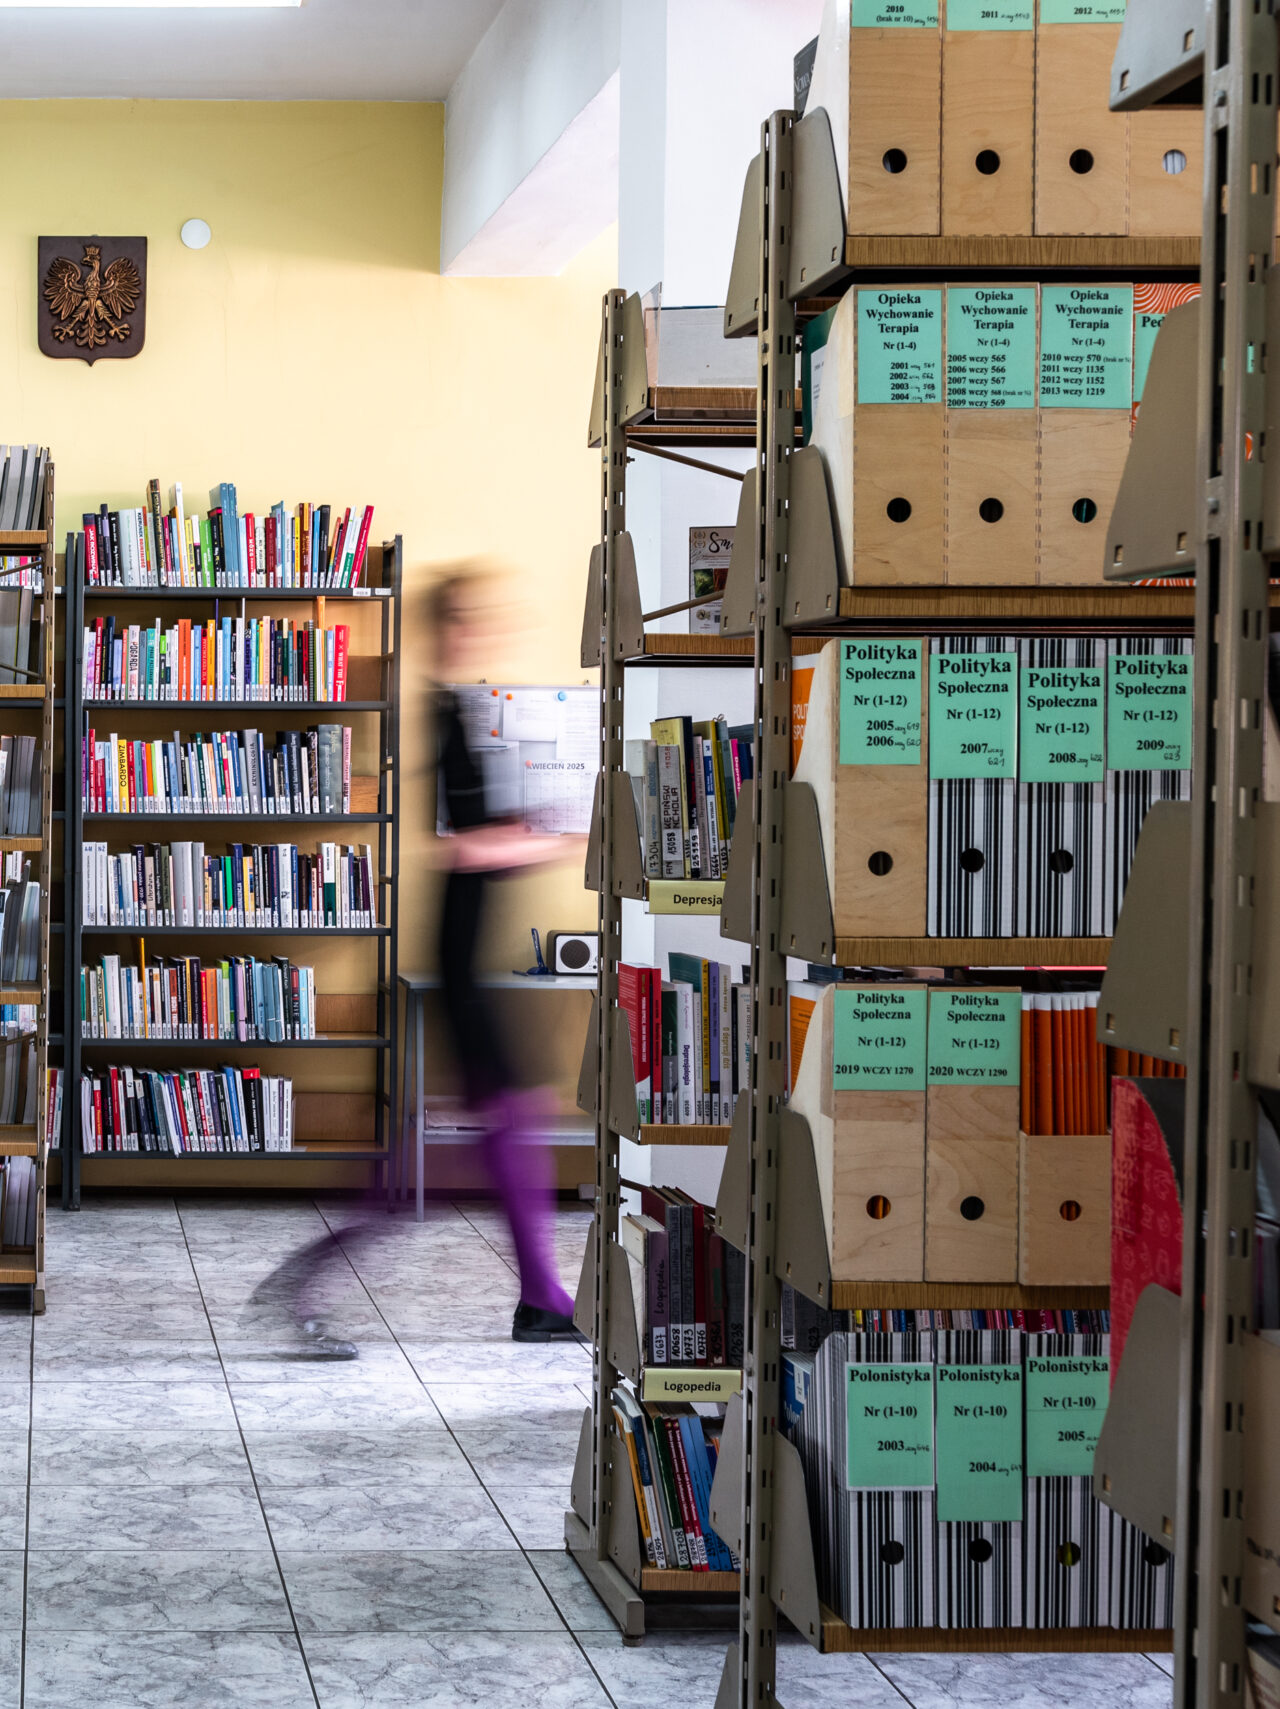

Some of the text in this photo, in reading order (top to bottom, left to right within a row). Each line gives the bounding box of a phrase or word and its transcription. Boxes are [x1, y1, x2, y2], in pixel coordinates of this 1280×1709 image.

[878, 294, 921, 306] Opieka
[975, 291, 1013, 302] Opieka
[1070, 290, 1109, 302] Opieka
[866, 309, 933, 321] Wychowanie
[961, 305, 1028, 317] Wychowanie
[1056, 304, 1123, 316] Wychowanie
[878, 323, 919, 335] Terapia
[974, 320, 1014, 331] Terapia
[1069, 319, 1109, 331] Terapia
[897, 342, 916, 351] (1-4)
[991, 338, 1010, 347] (1-4)
[1085, 338, 1105, 347] (1-4)
[845, 645, 917, 663] Polityka
[939, 659, 1011, 677] Polityka
[1115, 660, 1188, 679] Polityka
[846, 668, 915, 682] Społeczna
[1028, 673, 1100, 691] Polityka
[938, 682, 1008, 697] Społeczna
[1115, 683, 1186, 698] Społeczna
[854, 695, 907, 707] Nr (1-12)
[1027, 696, 1097, 711] Społeczna
[947, 709, 1001, 720] Nr (1-12)
[1123, 711, 1178, 723] Nr (1-12)
[867, 721, 894, 730] 2005
[1036, 723, 1089, 735] Nr (1-12)
[867, 736, 894, 746] 2006
[1137, 740, 1164, 750] 2009
[961, 744, 988, 753] 2007
[1049, 753, 1076, 763] 2008
[673, 894, 722, 906] Depresja
[857, 994, 904, 1006] Polityka
[951, 995, 999, 1008] Polityka
[853, 1010, 911, 1021] Społeczna
[947, 1011, 1005, 1023] Społeczna
[858, 1037, 906, 1048] Nr (1-12)
[952, 1039, 999, 1050] Nr (1-12)
[835, 1065, 859, 1074] 2019
[930, 1067, 953, 1076] 2020
[655, 1332, 665, 1359] 10637
[1029, 1360, 1108, 1374] Polonistyka
[850, 1370, 930, 1384] Polonistyka
[939, 1370, 1020, 1384] Polonistyka
[664, 1382, 721, 1392] Logopedia
[1043, 1397, 1096, 1409] Nr (1-10)
[864, 1406, 917, 1418] Nr (1-10)
[954, 1406, 1007, 1418] Nr (1-10)
[1058, 1431, 1085, 1441] 2005
[878, 1441, 904, 1451] 2003
[969, 1462, 996, 1472] 2004
[675, 1531, 689, 1562] 28708
